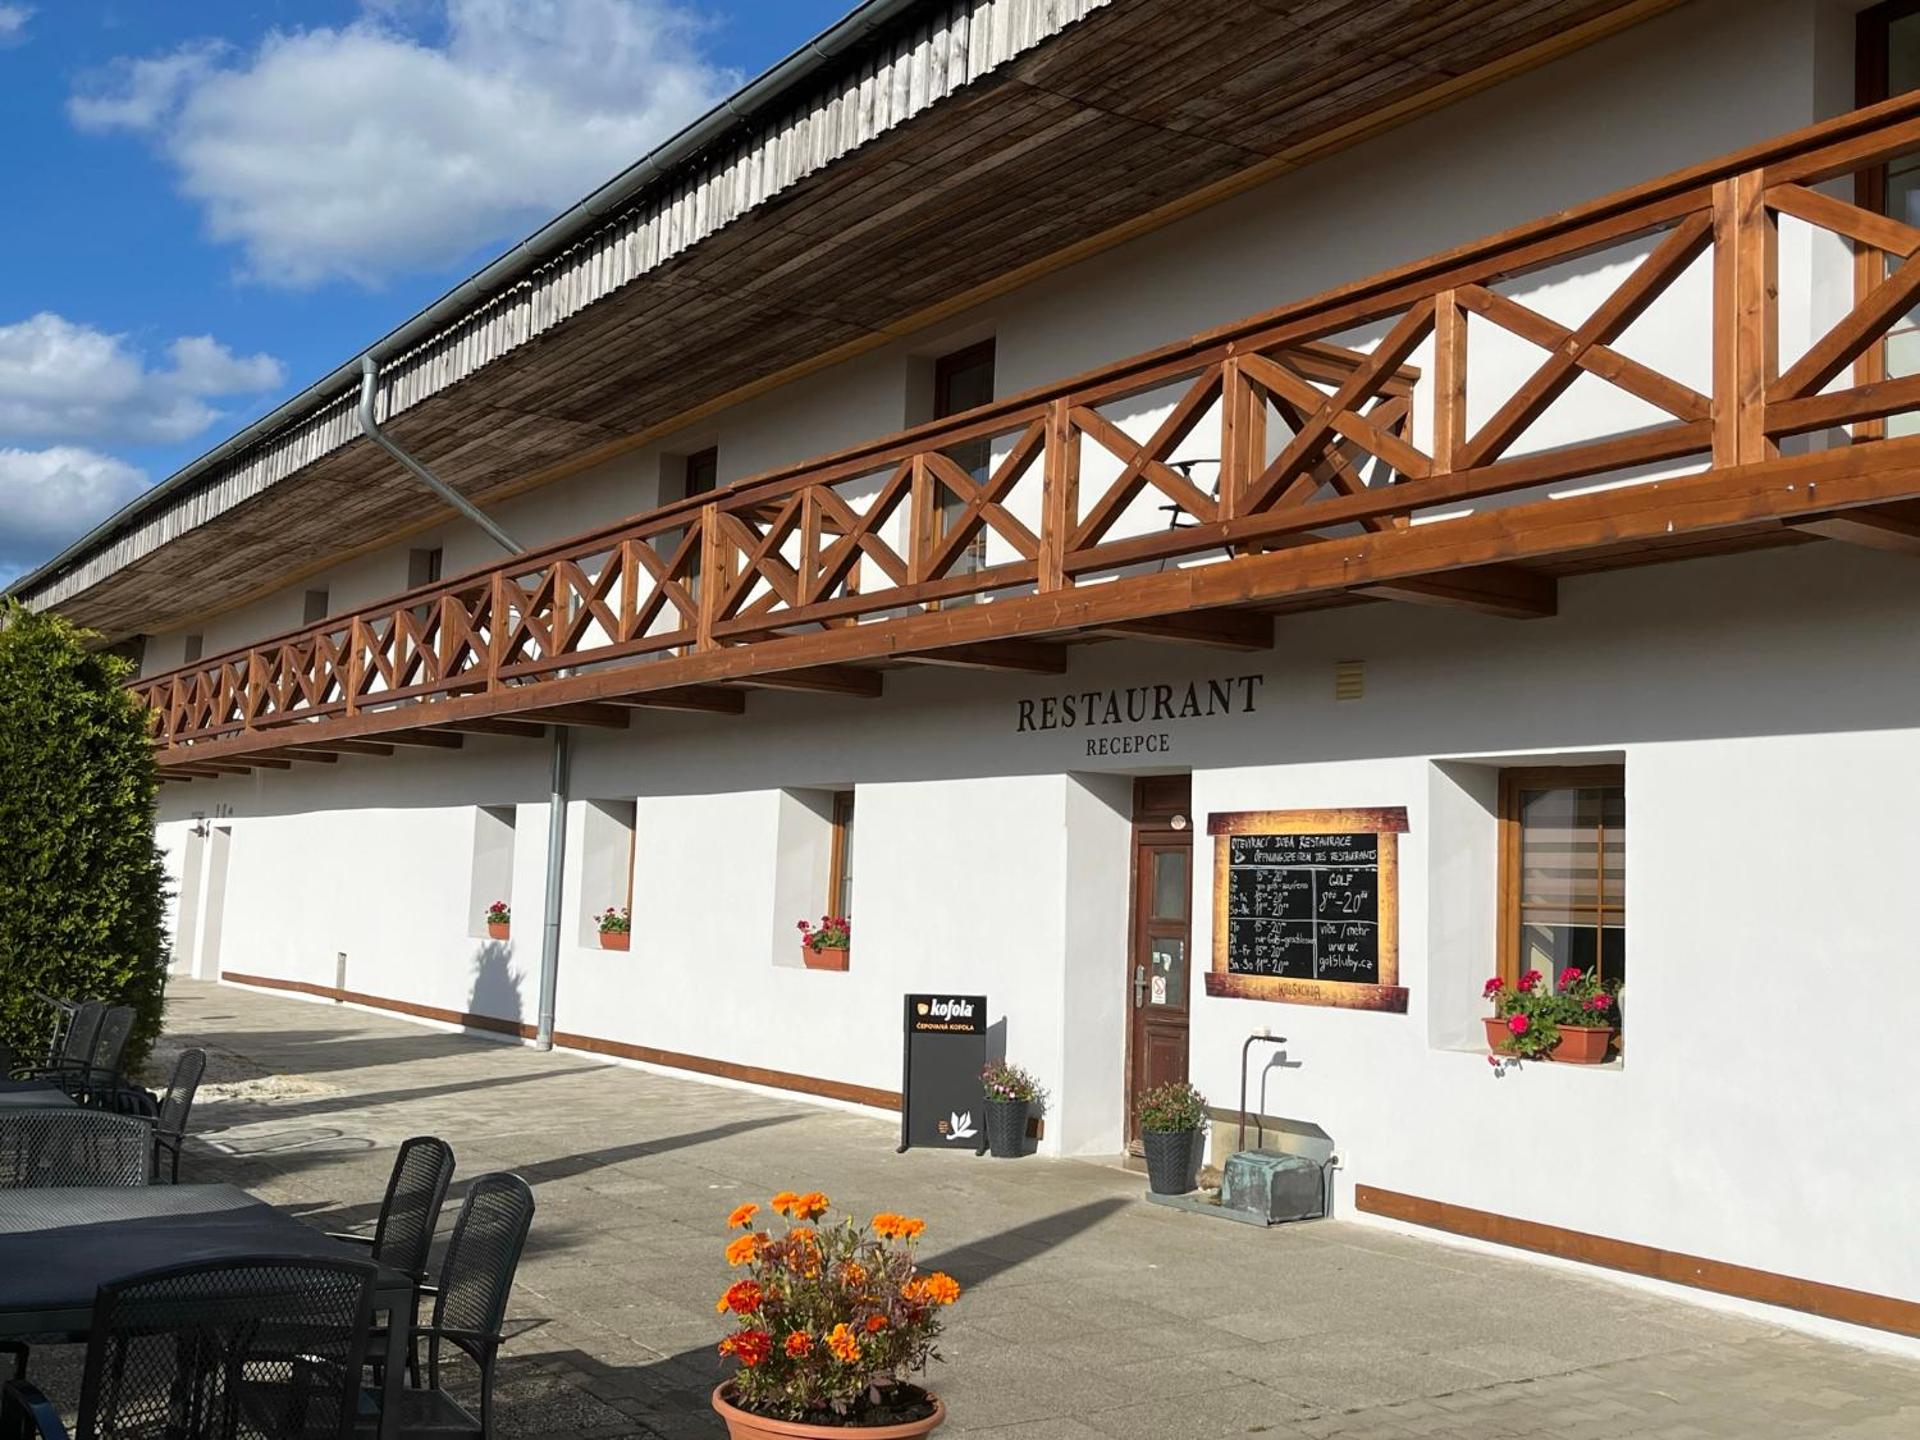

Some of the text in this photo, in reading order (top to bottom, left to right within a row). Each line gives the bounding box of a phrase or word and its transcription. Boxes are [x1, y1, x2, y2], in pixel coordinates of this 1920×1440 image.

[1016, 675, 1263, 732] RESTAURANT
[1086, 734, 1170, 756] RECEPCE
[1329, 873, 1353, 886] GOLF
[930, 998, 973, 1021] kofola
[916, 1022, 974, 1031] ČEPOVANÁ KOFOLA
